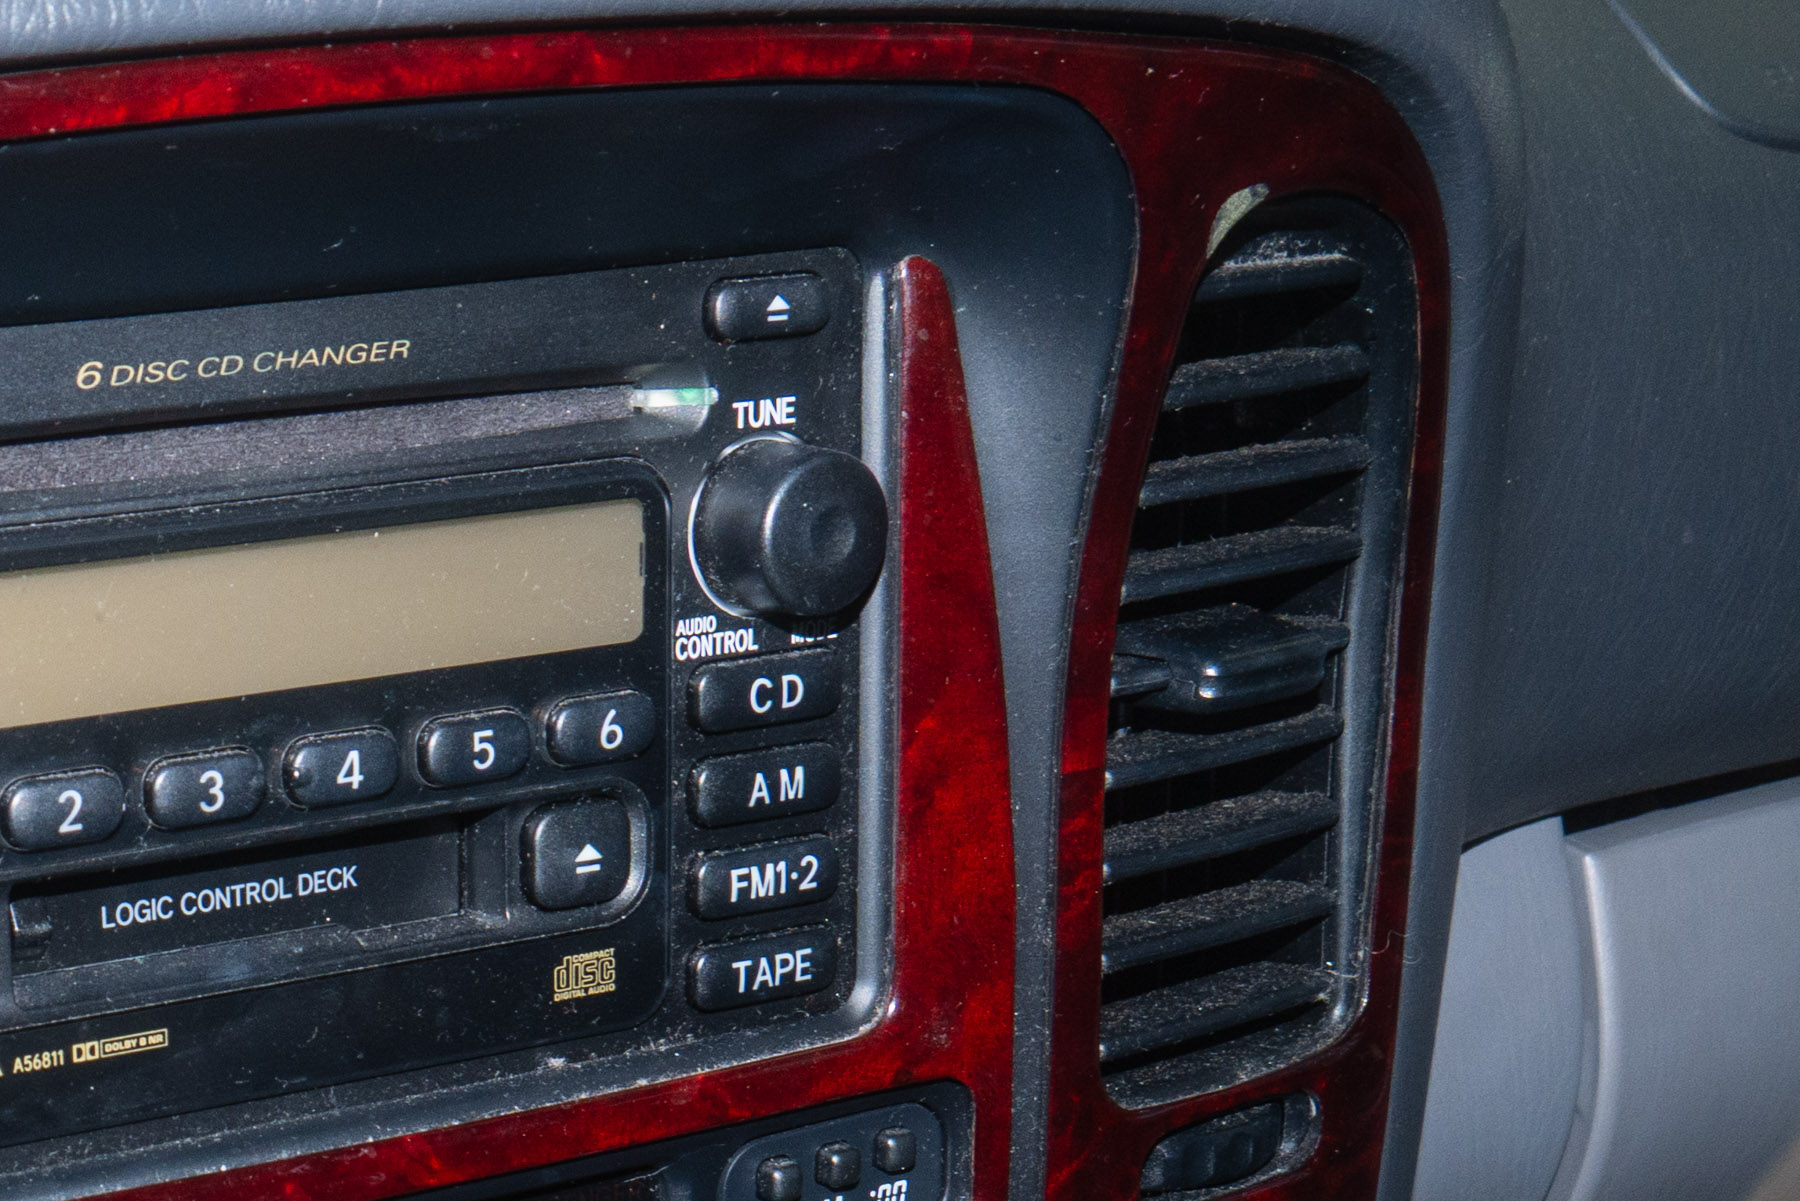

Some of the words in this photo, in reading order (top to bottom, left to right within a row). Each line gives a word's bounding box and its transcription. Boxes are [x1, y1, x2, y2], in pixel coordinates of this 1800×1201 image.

[76, 361, 103, 389] 6
[109, 360, 189, 386] DISC
[197, 354, 244, 378] CD
[253, 339, 411, 373] CHANGER
[732, 396, 797, 429] TUNE
[675, 614, 717, 637] AUDIO
[675, 627, 759, 661] CONTROL
[750, 673, 804, 714] CD
[600, 708, 623, 749] 6
[471, 729, 496, 770] 5
[200, 769, 225, 813] 3
[335, 750, 364, 791] 4
[748, 765, 804, 808] AM
[58, 790, 83, 835] 2
[101, 895, 174, 929] LOGIC
[180, 876, 292, 916] CONTROL
[297, 865, 358, 897] DECK
[572, 948, 615, 962] COMPACT
[731, 948, 813, 993] TAPE
[554, 988, 587, 1001] DIGITAL
[587, 983, 616, 995] AUDIO
[12, 1050, 65, 1075] A56811
[104, 1038, 138, 1053] DOLBY
